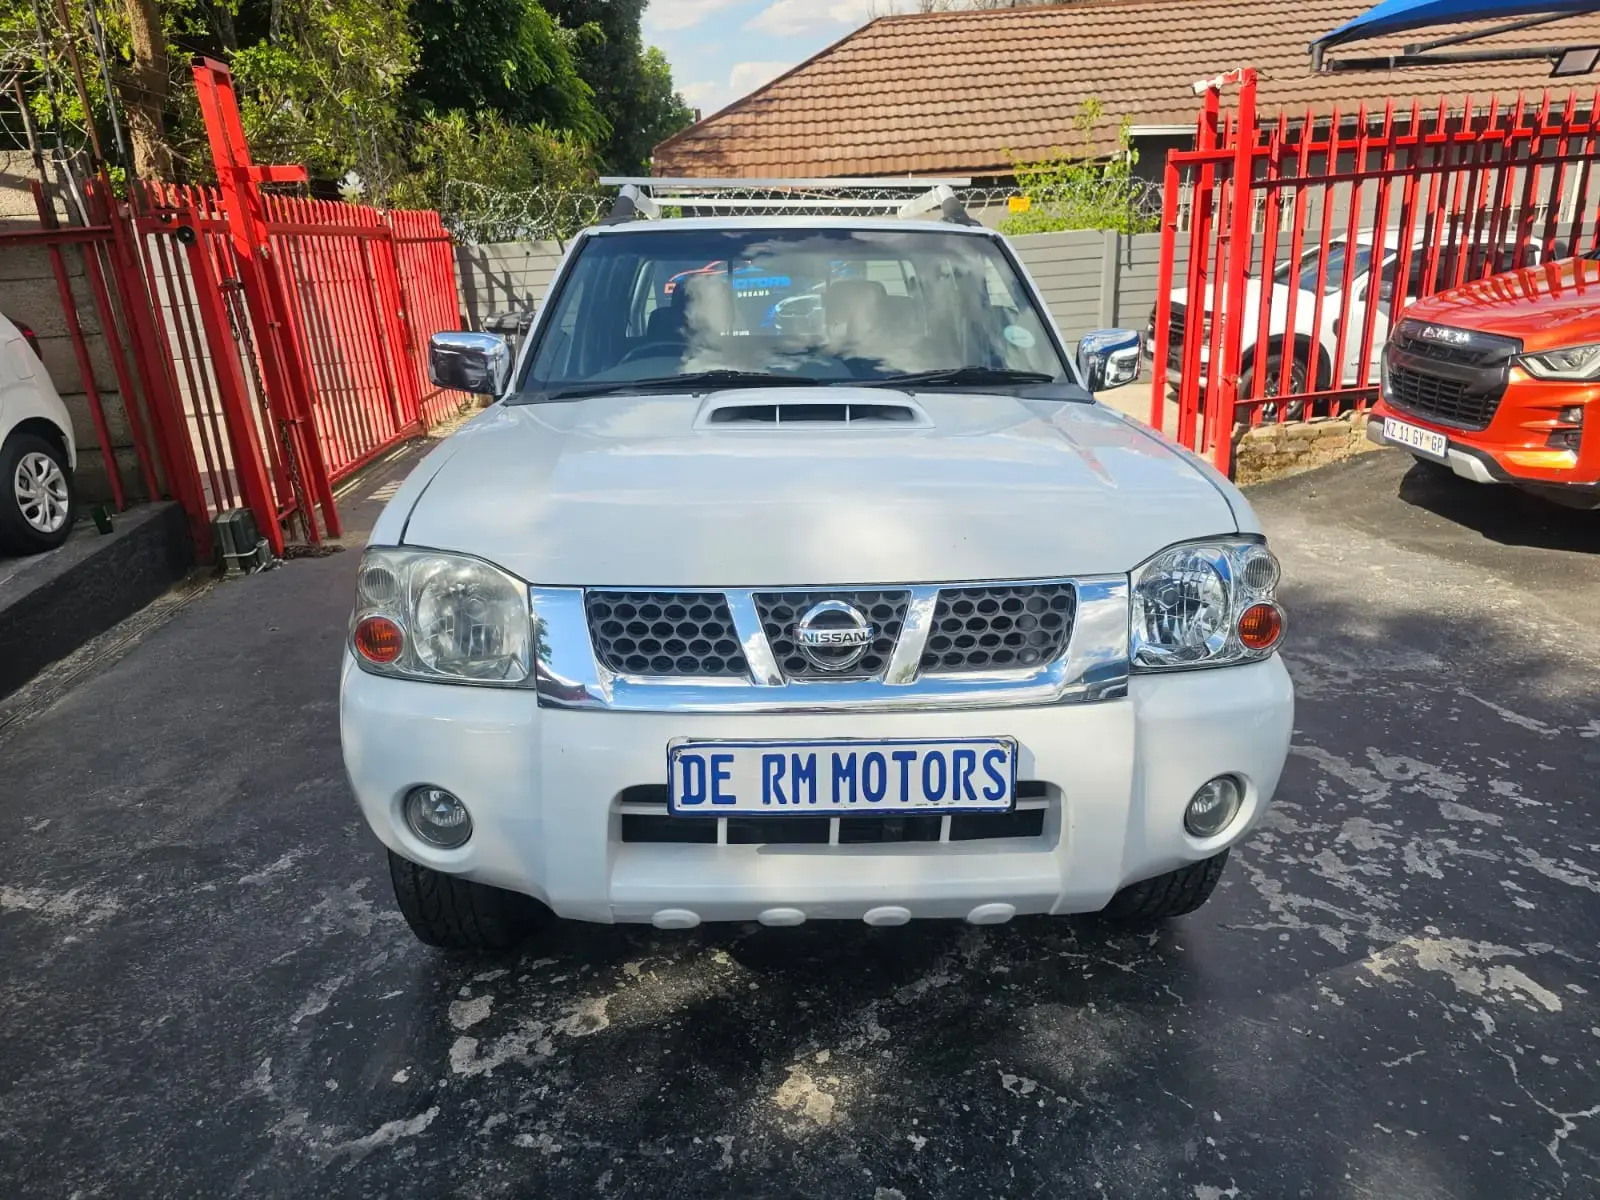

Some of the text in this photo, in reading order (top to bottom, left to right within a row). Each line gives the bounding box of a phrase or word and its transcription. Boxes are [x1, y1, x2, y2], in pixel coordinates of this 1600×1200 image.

[1386, 420, 1397, 437] KZ
[1399, 425, 1409, 442] 11
[1431, 435, 1443, 453] GP
[803, 631, 866, 643] NISSAN
[680, 749, 1007, 805] DE RM MOTORS
